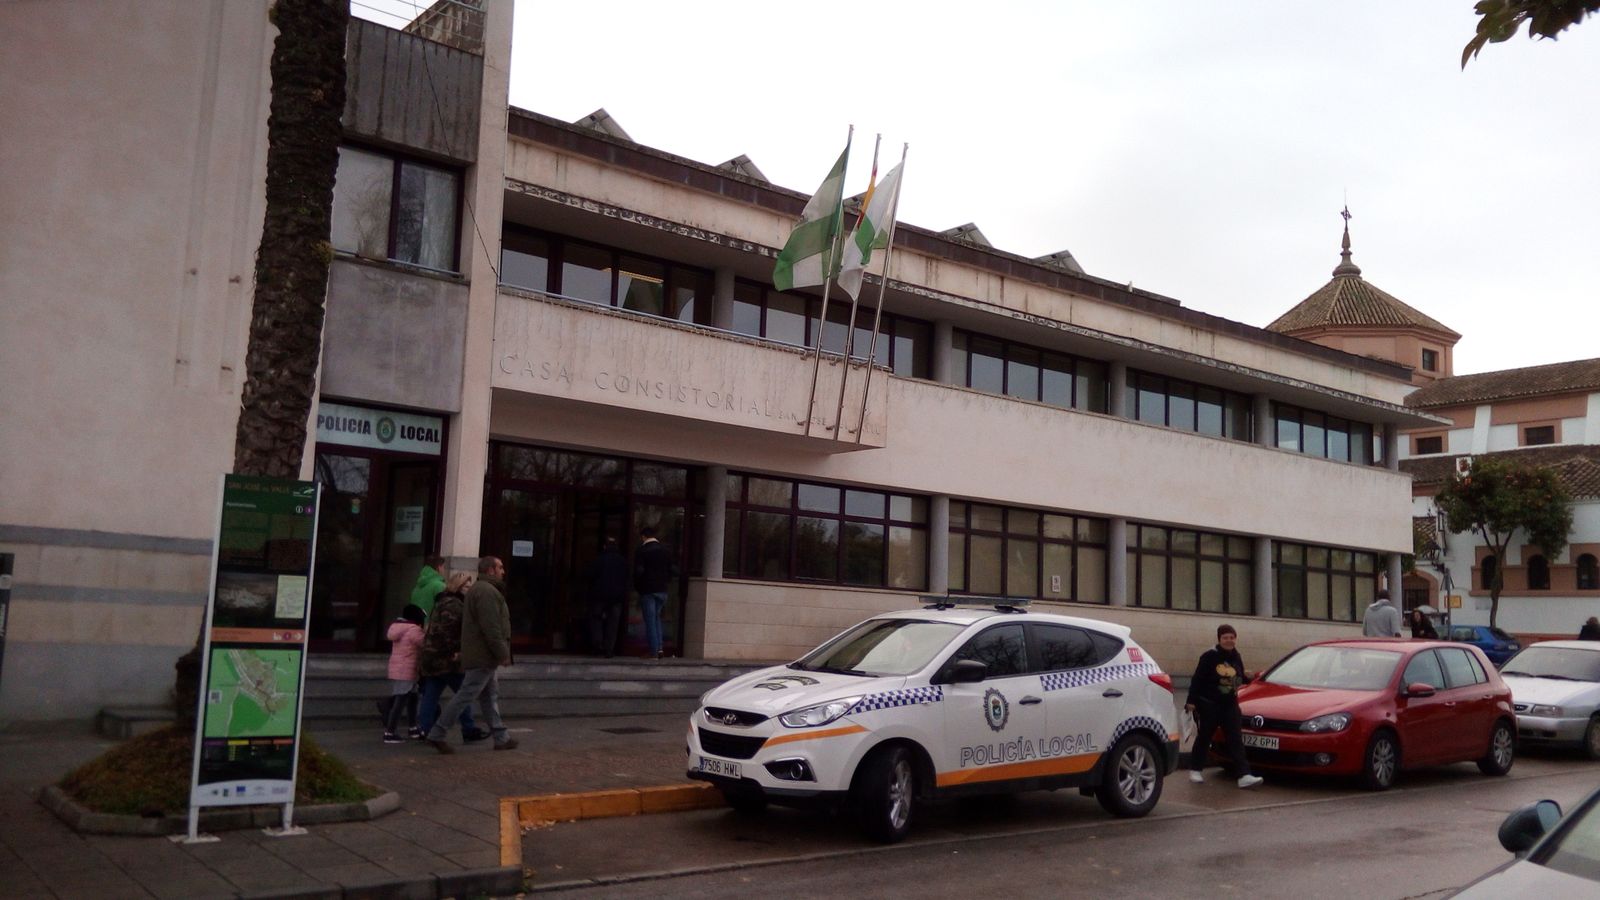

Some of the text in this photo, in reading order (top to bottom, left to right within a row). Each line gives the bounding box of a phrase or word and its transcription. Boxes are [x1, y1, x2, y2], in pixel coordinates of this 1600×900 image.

[500, 354, 773, 417] CASA CONSISTORIAL
[317, 415, 440, 443] POLICIA LOCAL
[960, 733, 1097, 767] POLICÍA LOCAL
[704, 759, 721, 773] 7506
